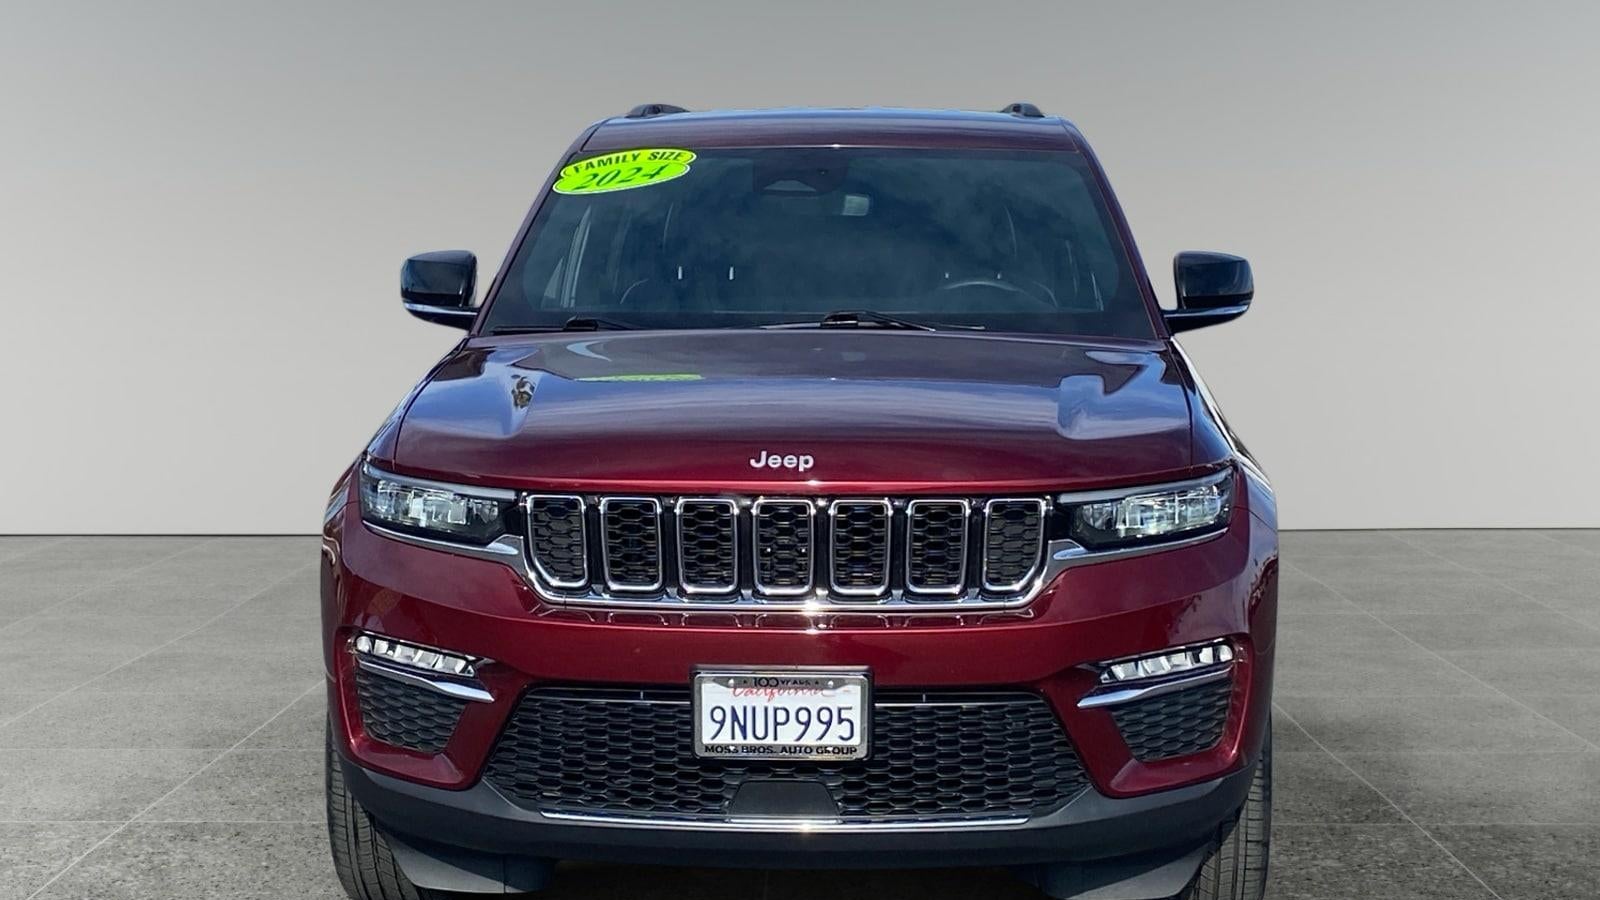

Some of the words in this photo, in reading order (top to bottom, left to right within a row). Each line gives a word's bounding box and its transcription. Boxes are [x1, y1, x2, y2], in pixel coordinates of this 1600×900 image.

[573, 152, 641, 174] FAMILY
[648, 151, 685, 161] SIZE
[571, 162, 670, 191] 2024
[749, 450, 815, 472] Jeep
[710, 705, 854, 741] 9NUP995
[704, 745, 739, 754] MOSS
[741, 745, 777, 754] BROS.
[780, 746, 813, 754] AUTO
[815, 746, 858, 755] GROUP
